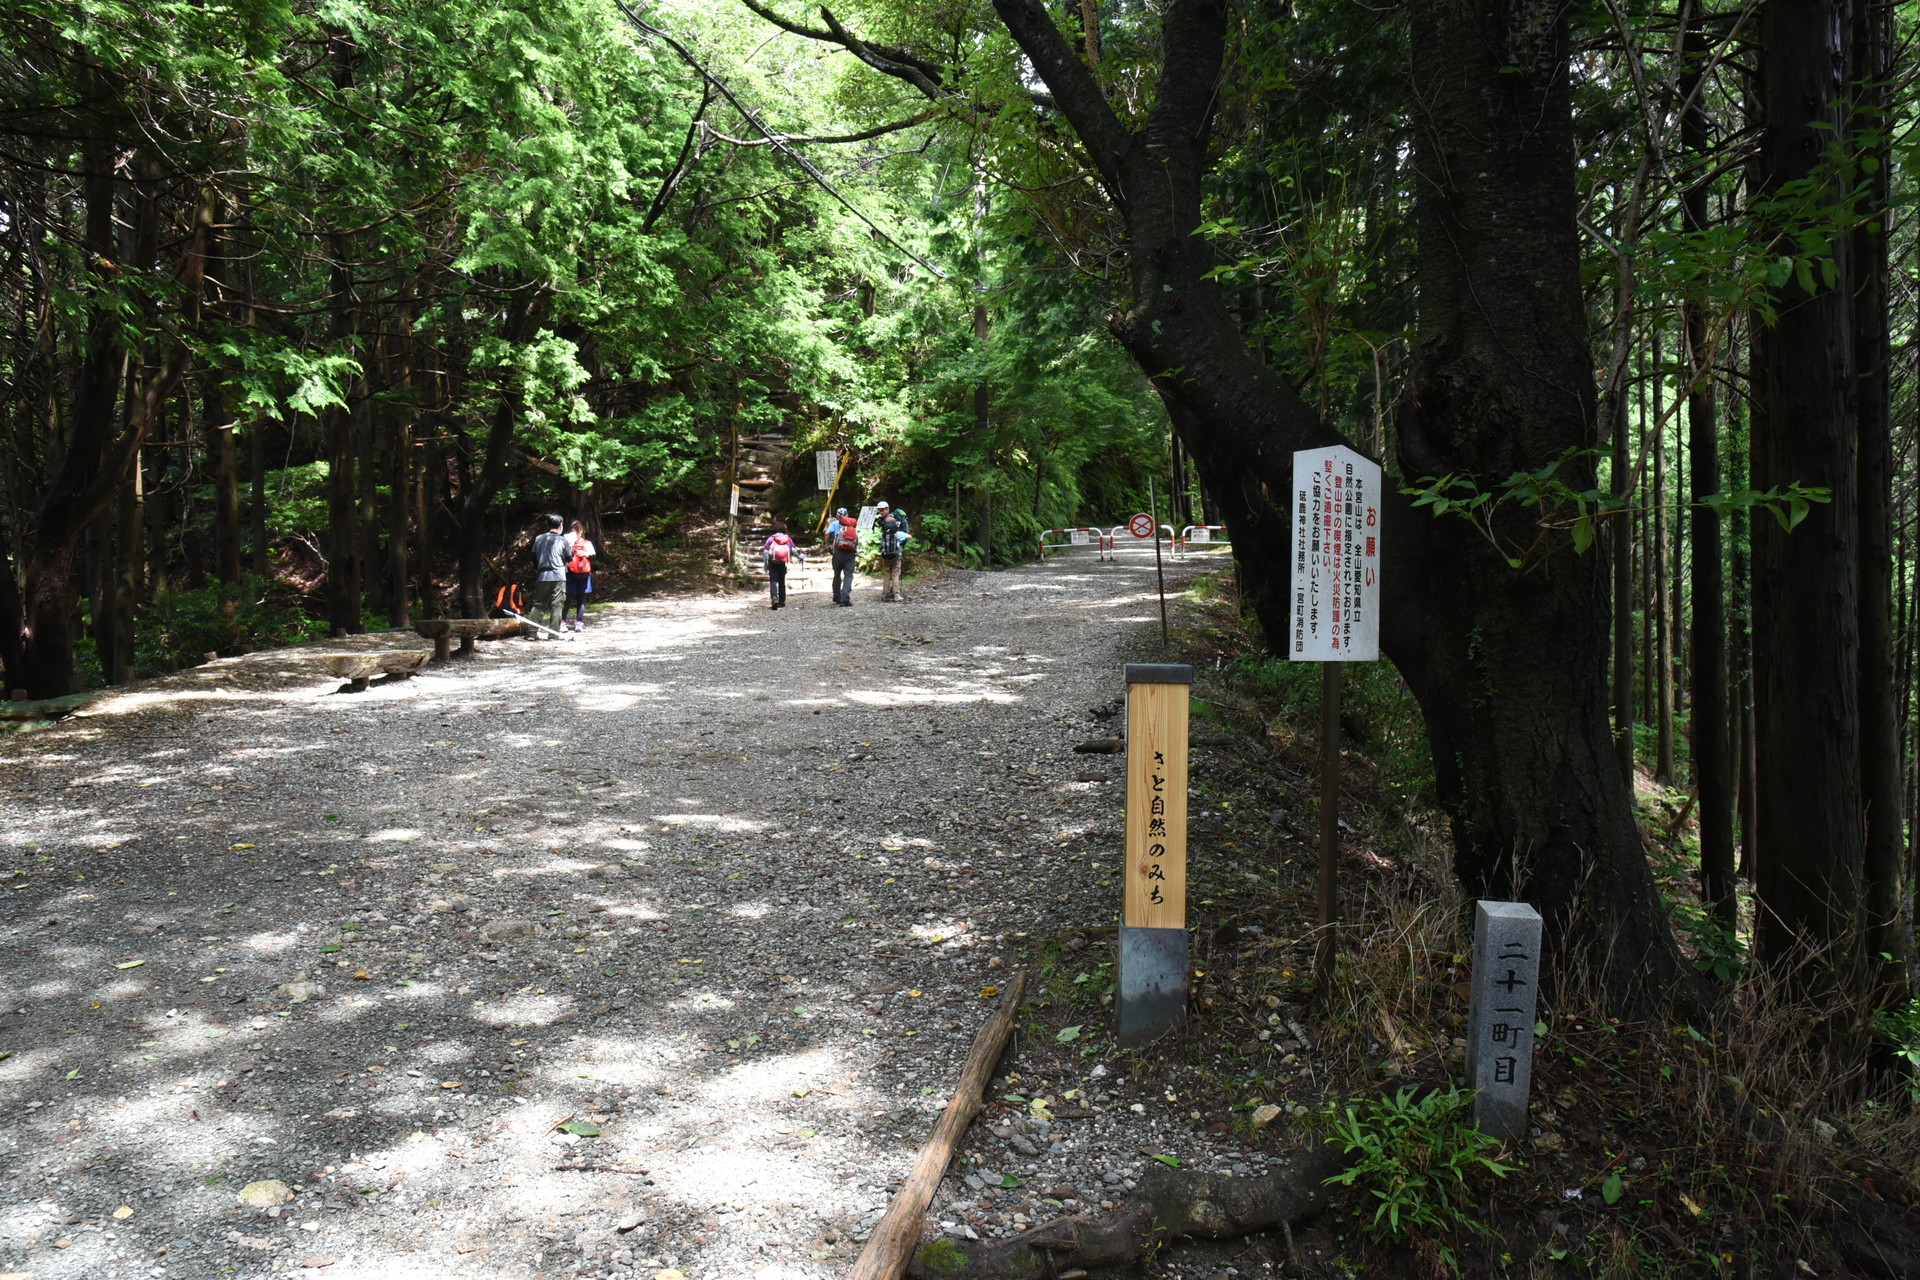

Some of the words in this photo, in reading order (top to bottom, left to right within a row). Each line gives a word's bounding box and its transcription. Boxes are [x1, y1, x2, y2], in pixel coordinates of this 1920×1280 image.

[1310, 472, 1321, 639] ご協力をお願いいたします。
[1323, 460, 1332, 573] 堅くご遠慮下さい。
[1343, 463, 1353, 653] 自然公園に指定されております。
[1366, 506, 1376, 587] お願い
[1148, 750, 1166, 906] さと自然のみち
[1492, 942, 1529, 1086] 二十一町目
